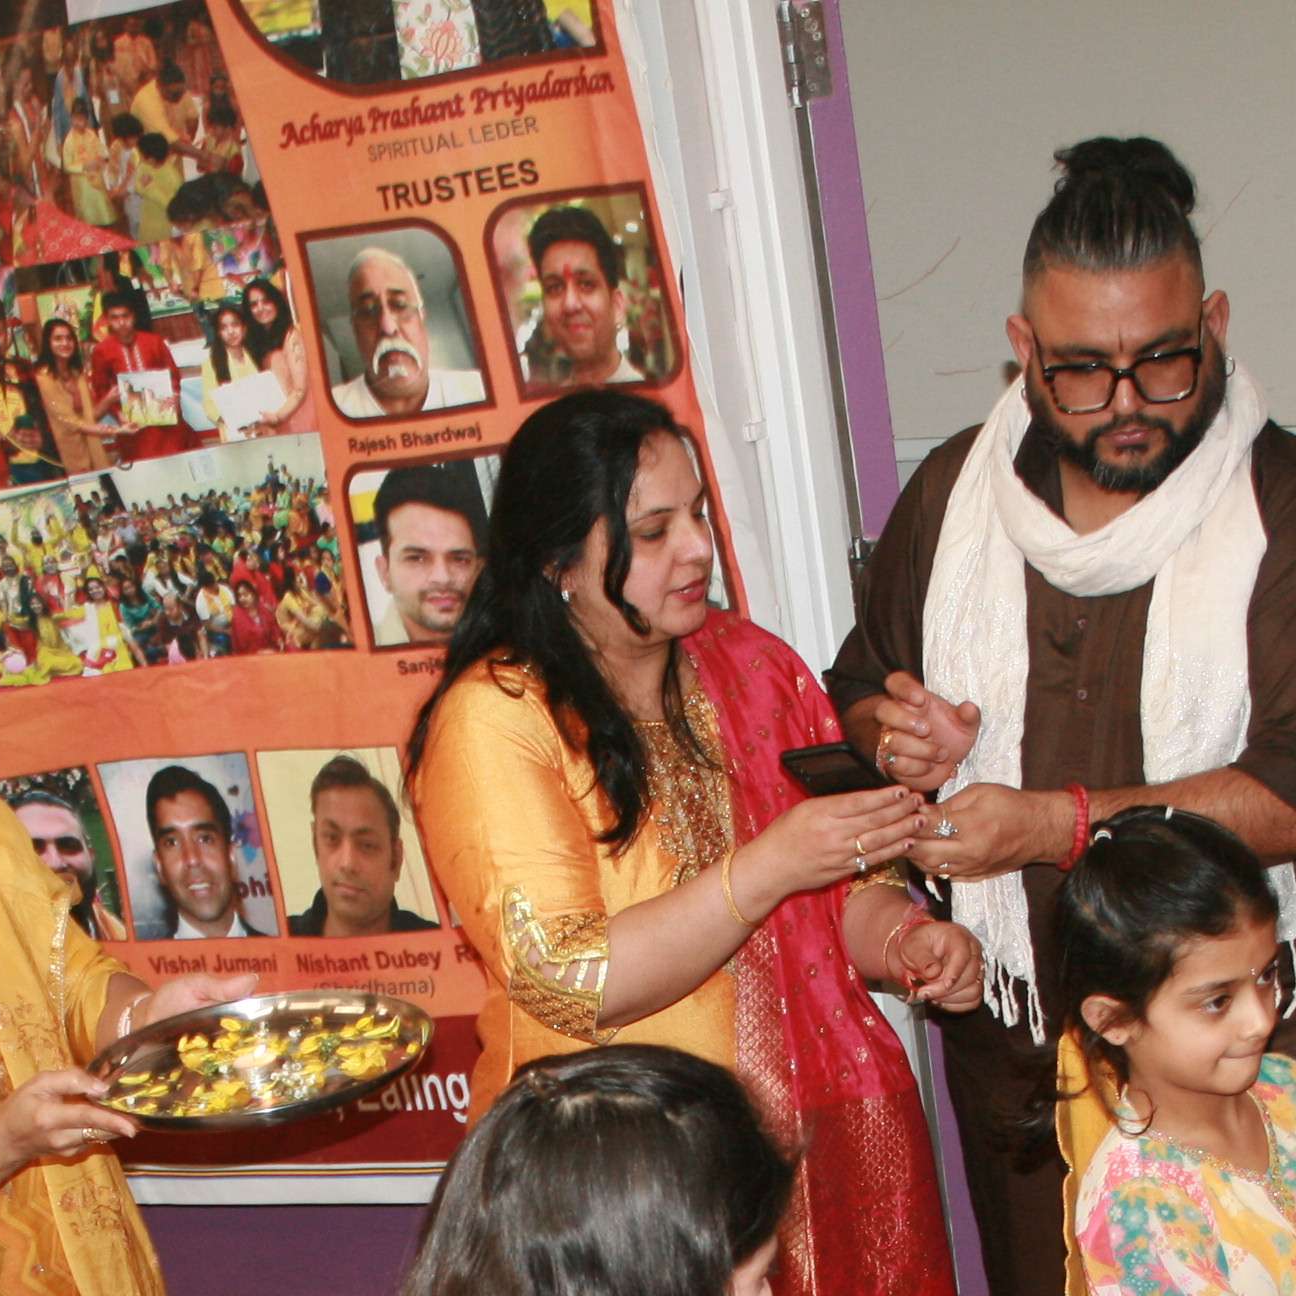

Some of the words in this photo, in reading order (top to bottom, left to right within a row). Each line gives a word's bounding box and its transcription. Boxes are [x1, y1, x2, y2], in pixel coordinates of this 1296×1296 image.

[280, 112, 365, 149] Acharya
[368, 96, 465, 134] Prashant
[470, 65, 615, 116] Priyadarshan
[367, 130, 463, 162] SPIRITUAL
[469, 116, 539, 145] LEDER
[376, 159, 539, 212] TRUSTEES
[348, 436, 397, 455] Rajesh
[400, 422, 482, 448] Bhardwaj
[148, 953, 207, 975] Vishal
[213, 953, 277, 974] Jumani
[295, 953, 371, 974] Nishant
[374, 949, 441, 971] Dubey
